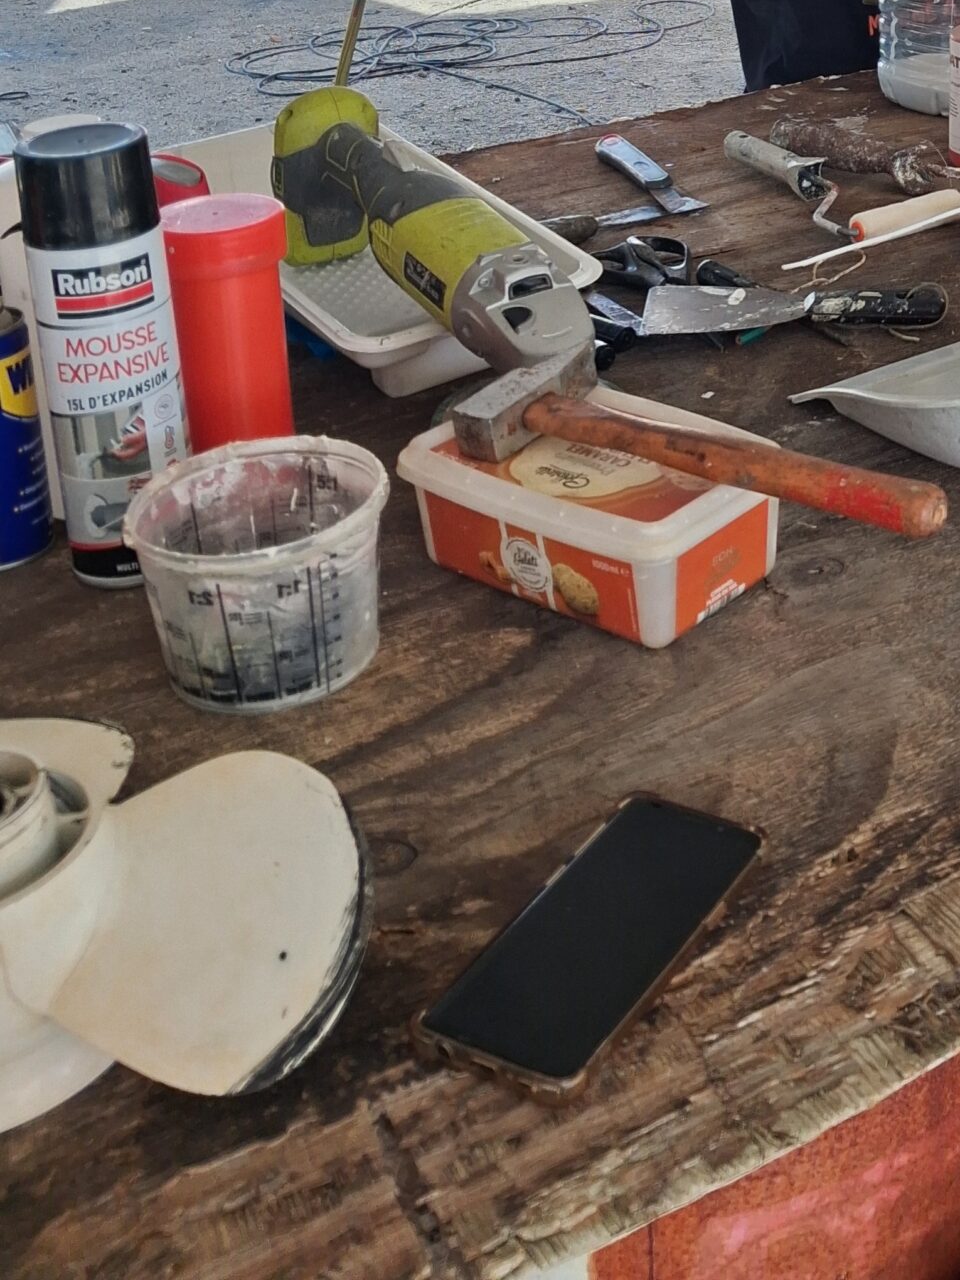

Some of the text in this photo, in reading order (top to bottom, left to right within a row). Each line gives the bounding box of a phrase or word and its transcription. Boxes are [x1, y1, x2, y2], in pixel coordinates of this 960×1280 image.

[57, 264, 148, 296] Rubson
[65, 321, 158, 358] MOUSSE
[57, 341, 170, 384] EXPANSIVE
[67, 368, 169, 412] 15L D'EXPANSION
[566, 442, 631, 468] CARAMEL
